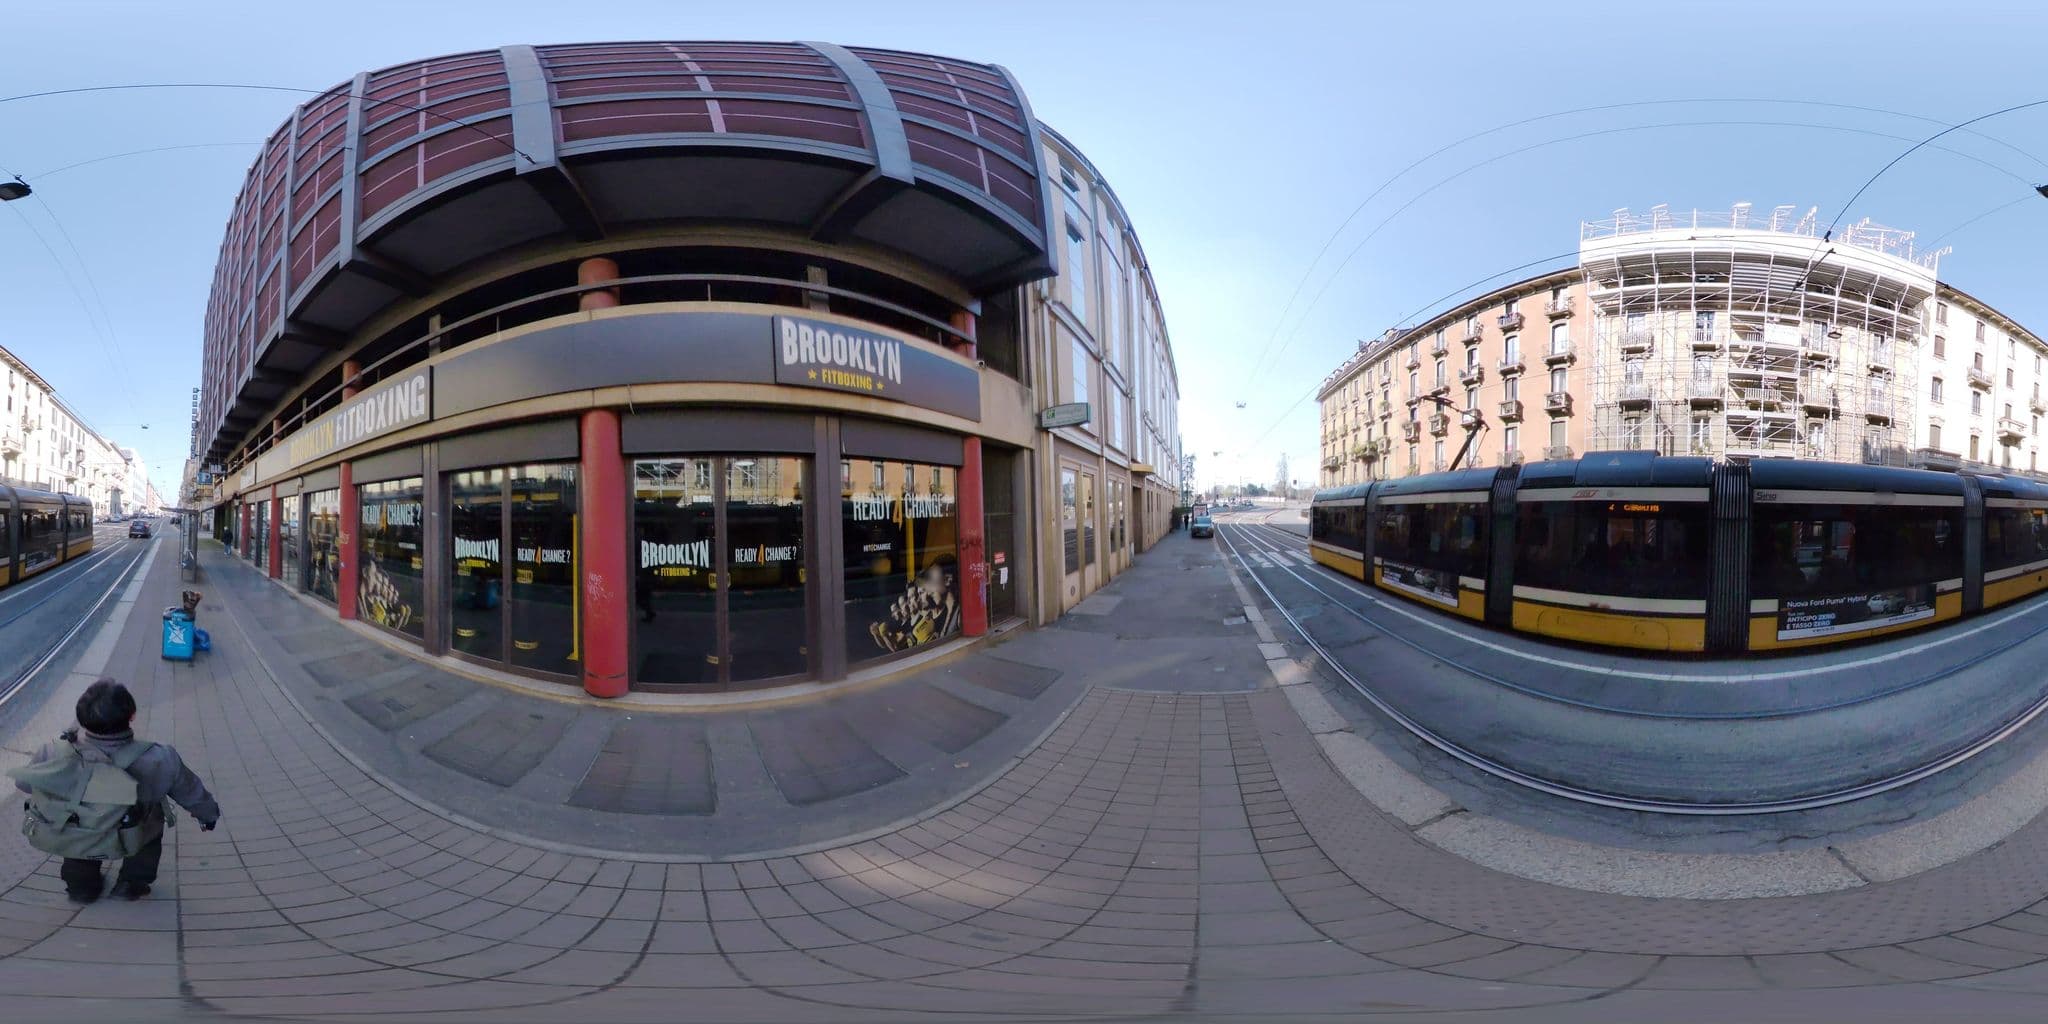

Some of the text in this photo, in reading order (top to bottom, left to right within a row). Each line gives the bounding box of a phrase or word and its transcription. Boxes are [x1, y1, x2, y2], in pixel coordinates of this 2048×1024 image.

[781, 317, 902, 384] BROOKLYN
[822, 368, 872, 390] FITBOXING
[336, 375, 425, 446] FITBOXING
[362, 505, 380, 525] READY
[387, 503, 415, 528] CHANGE
[853, 493, 890, 520] READY
[892, 495, 903, 532] 4
[904, 492, 943, 519] CHANGE
[454, 536, 499, 563] BROOKLYN
[517, 547, 535, 562] READY
[535, 545, 542, 567] 4
[542, 548, 566, 563] CHANGE
[637, 539, 710, 569] BROOKLYN
[735, 548, 757, 563] READY
[757, 543, 765, 566] 4
[765, 546, 791, 562] CHANGE
[1847, 594, 1867, 604] Hybrid
[1787, 614, 1817, 623] ANTICIPO
[1792, 621, 1812, 629] TASSO
[1813, 620, 1831, 628] ZERO
